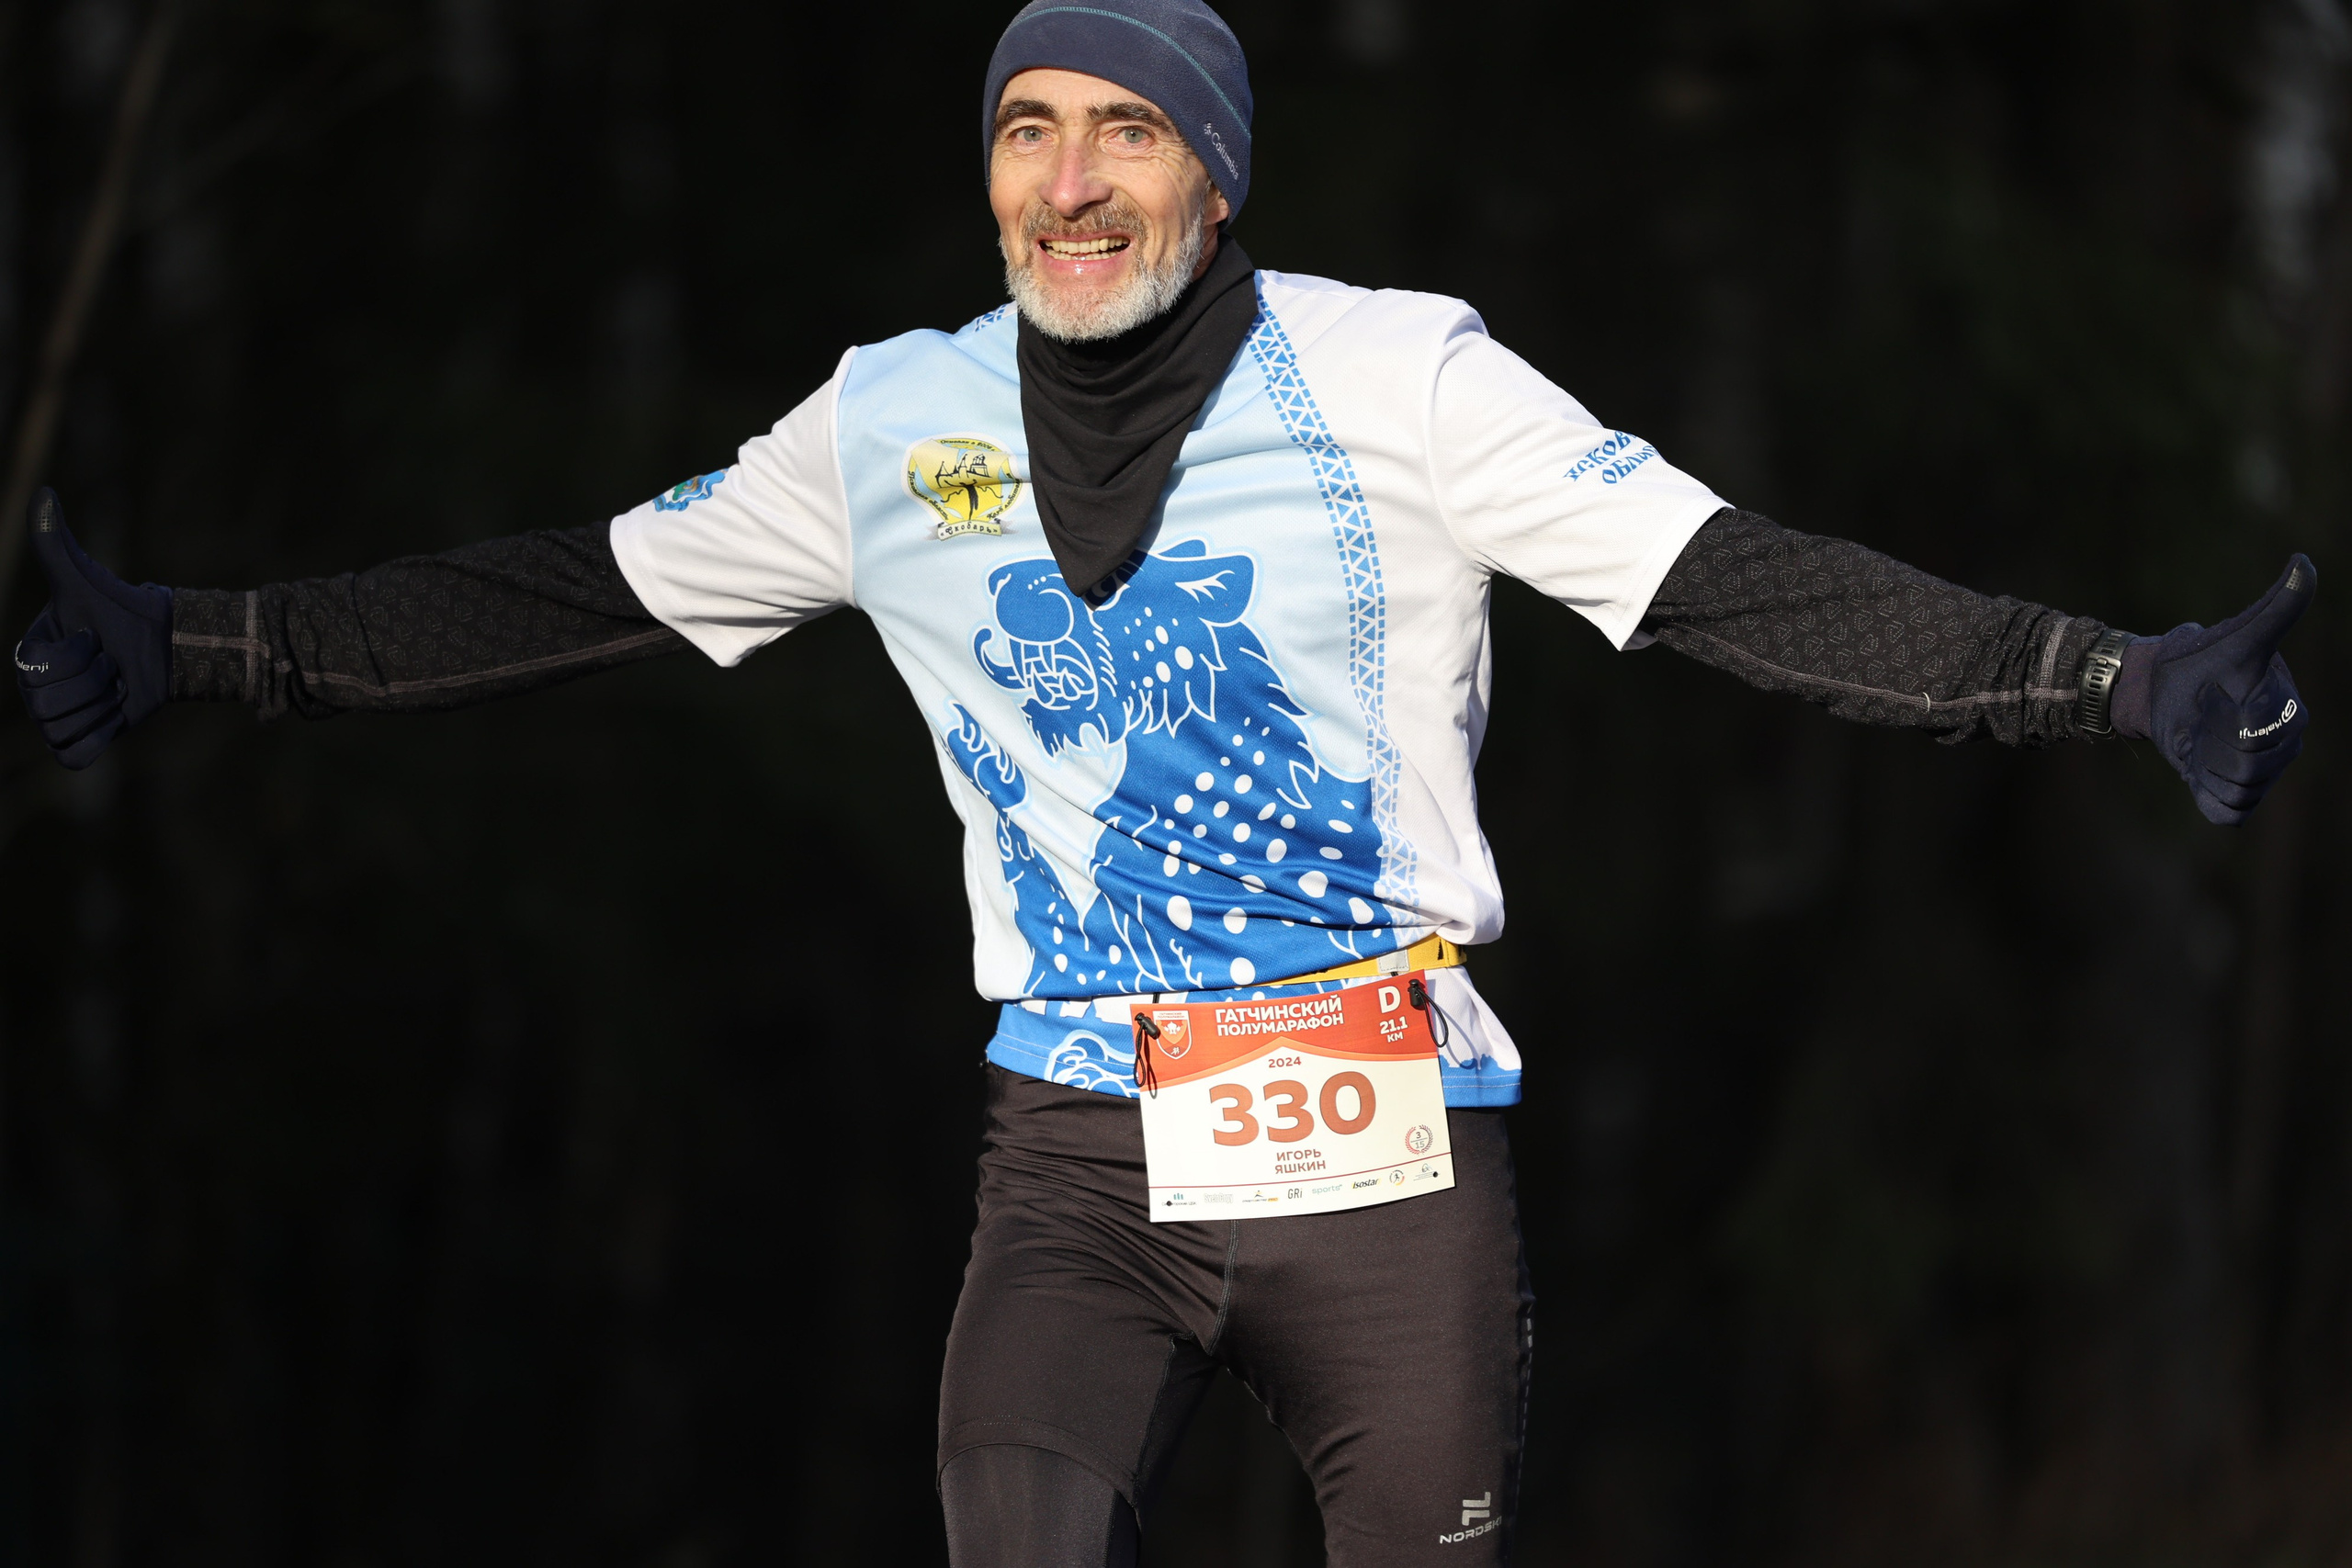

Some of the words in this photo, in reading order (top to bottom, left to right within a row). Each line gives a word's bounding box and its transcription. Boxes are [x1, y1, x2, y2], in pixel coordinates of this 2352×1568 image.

[1212, 132, 1238, 180] Columbia
[1378, 986, 1402, 1014] D
[1215, 994, 1343, 1023] ГАТЧИНСКИЙ
[1217, 1013, 1345, 1036] ПОЛУМАРАФОН
[1379, 1017, 1408, 1034] 21.1
[1386, 1031, 1404, 1043] КМ
[1268, 1056, 1302, 1068] 2024
[1208, 1071, 1377, 1146] 330
[1416, 1131, 1421, 1139] 3
[1415, 1140, 1425, 1149] 15
[1276, 1148, 1322, 1162] ИГОРЬ
[1274, 1160, 1327, 1175] ЯШКИН
[1352, 1179, 1378, 1190] isostar
[1287, 1188, 1303, 1200] GRi
[1439, 1516, 1502, 1544] NORDSKI
